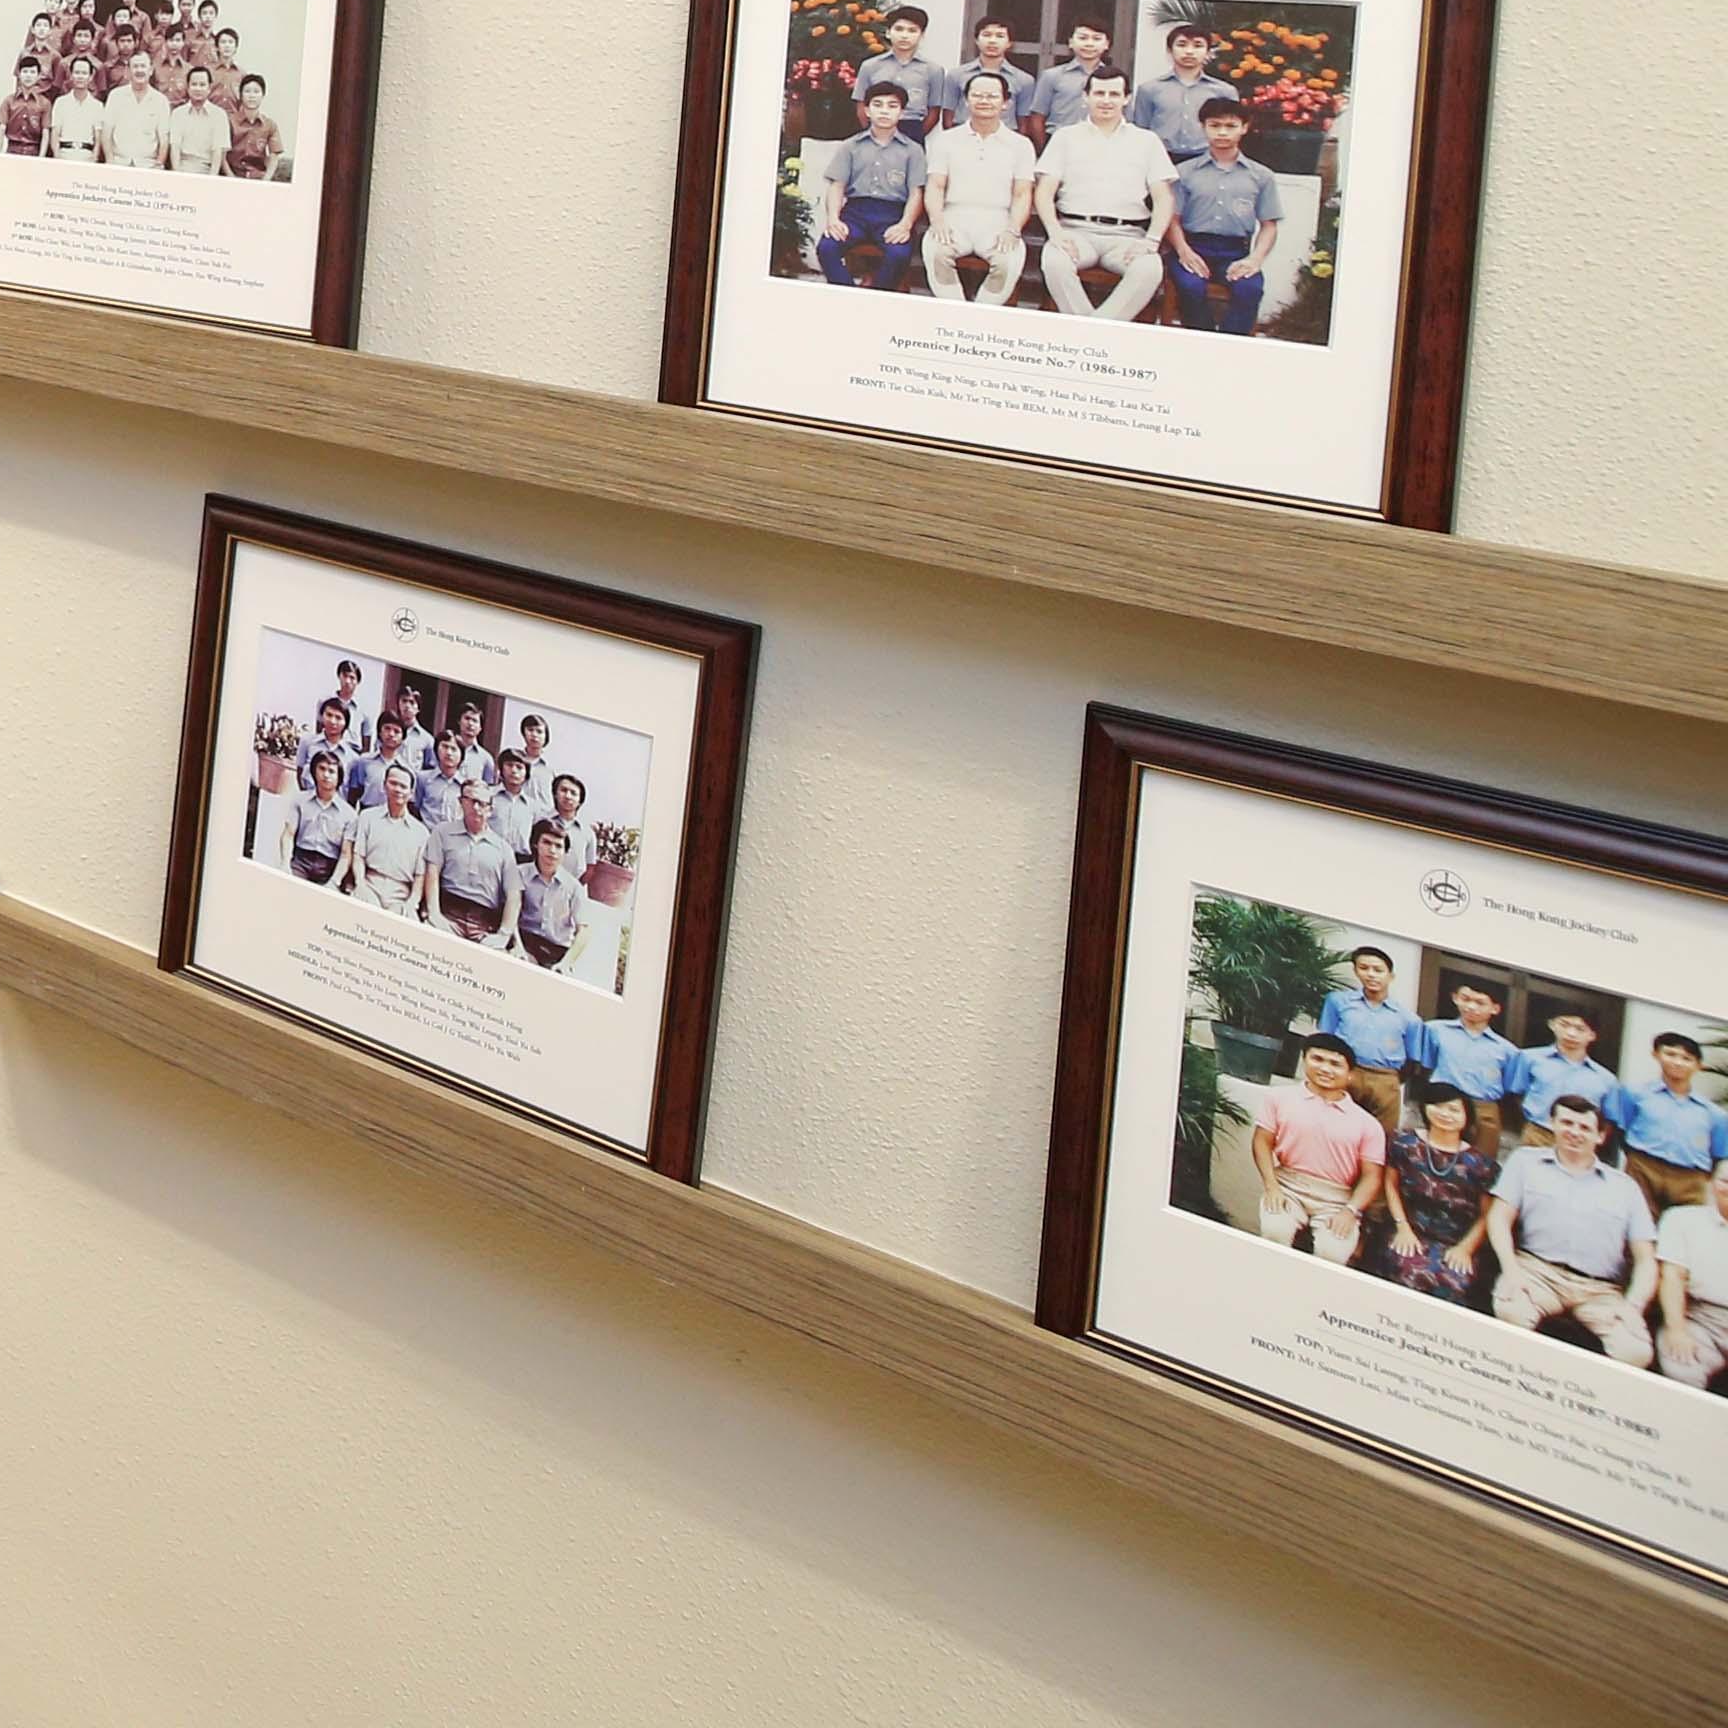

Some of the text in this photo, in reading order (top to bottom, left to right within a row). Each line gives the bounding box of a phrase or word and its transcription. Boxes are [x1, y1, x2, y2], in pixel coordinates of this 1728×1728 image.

[888, 335, 1158, 381] Apprentice Jockeys Course No.7 (1986-1987)
[934, 327, 1108, 357] The Royal Hong Kong Jockey Club
[1483, 898, 1638, 944] The Hong Kong Jockey Club
[1318, 1308, 1395, 1342] Apprentice
[1399, 1337, 1453, 1363] Jockeys
[1459, 1359, 1511, 1383] Course
[1376, 1313, 1596, 1398] The Royal Hong Kong Jockey Club
